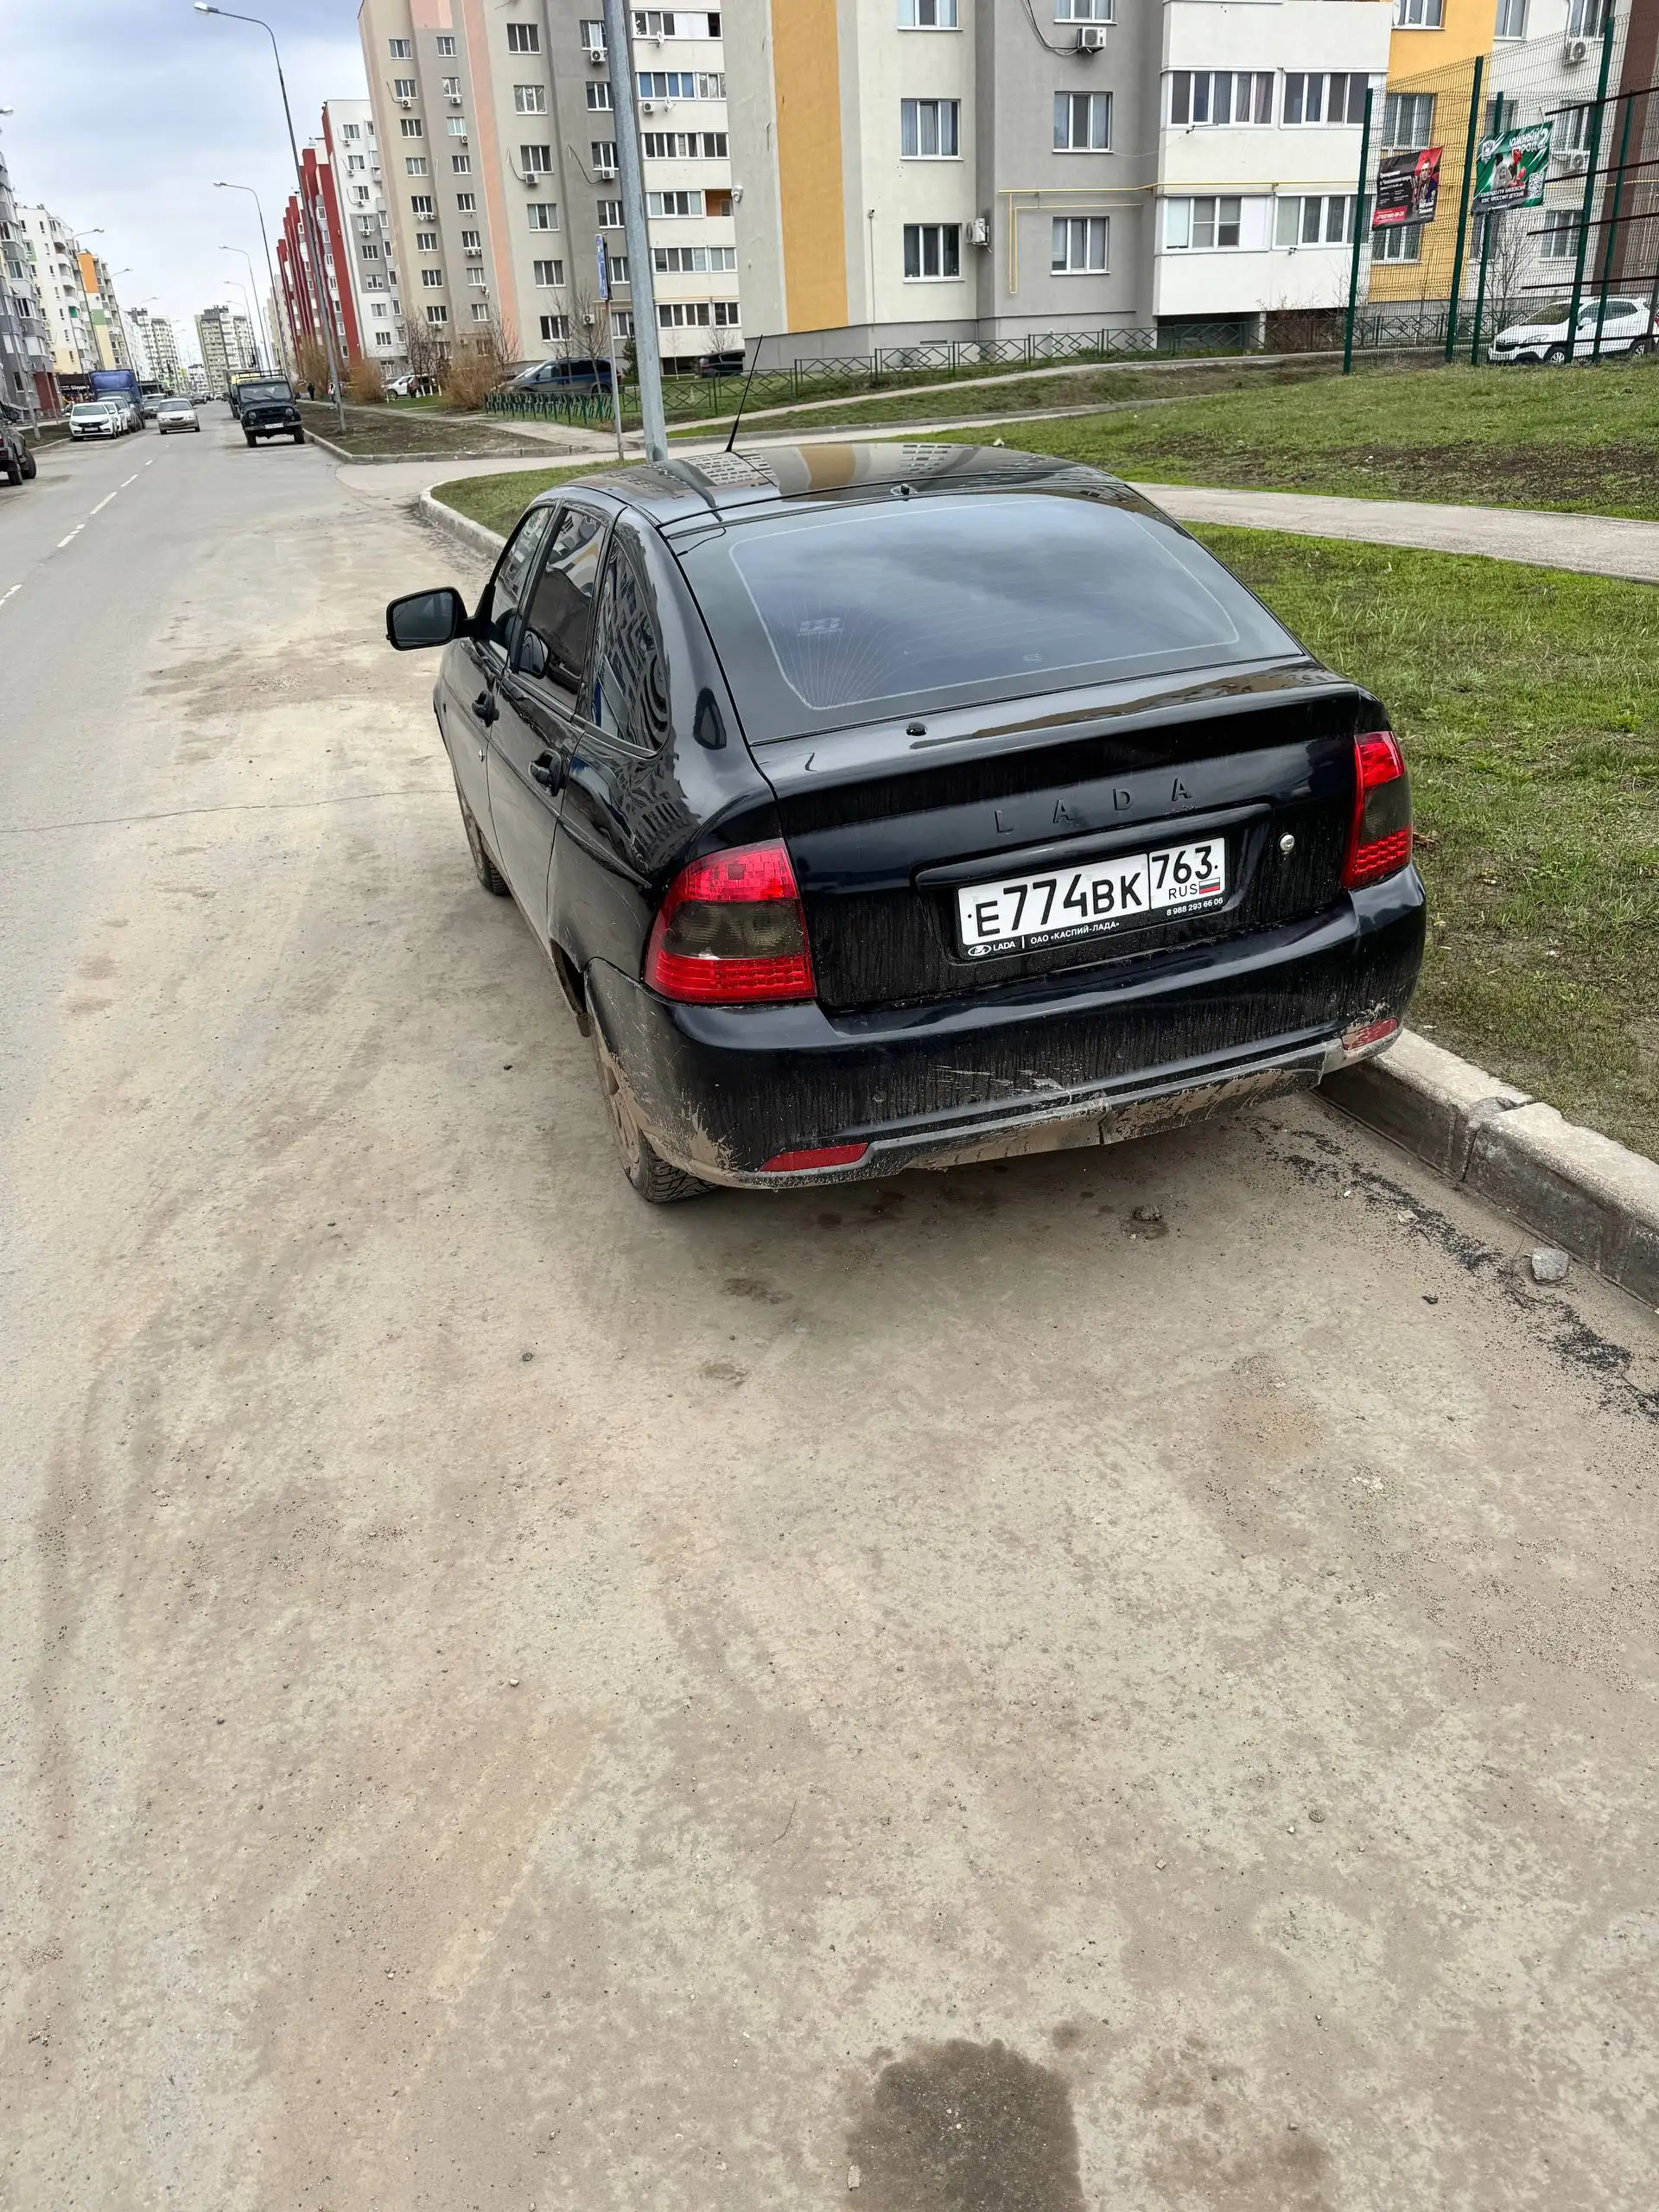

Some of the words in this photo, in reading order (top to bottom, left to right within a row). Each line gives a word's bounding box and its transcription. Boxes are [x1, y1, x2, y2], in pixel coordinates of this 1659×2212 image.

[995, 777, 1193, 834] LADA
[975, 872, 1142, 938] Е774ВК
[1152, 845, 1212, 889] 763
[1168, 884, 1198, 900] RUS
[1173, 906, 1187, 914] 988
[1188, 903, 1202, 912] 293
[1214, 897, 1224, 906] 06
[993, 941, 1016, 951] LADA
[1030, 934, 1049, 944] ОАО
[1051, 922, 1120, 940] «КАСПИЙ-ЛАДА»
